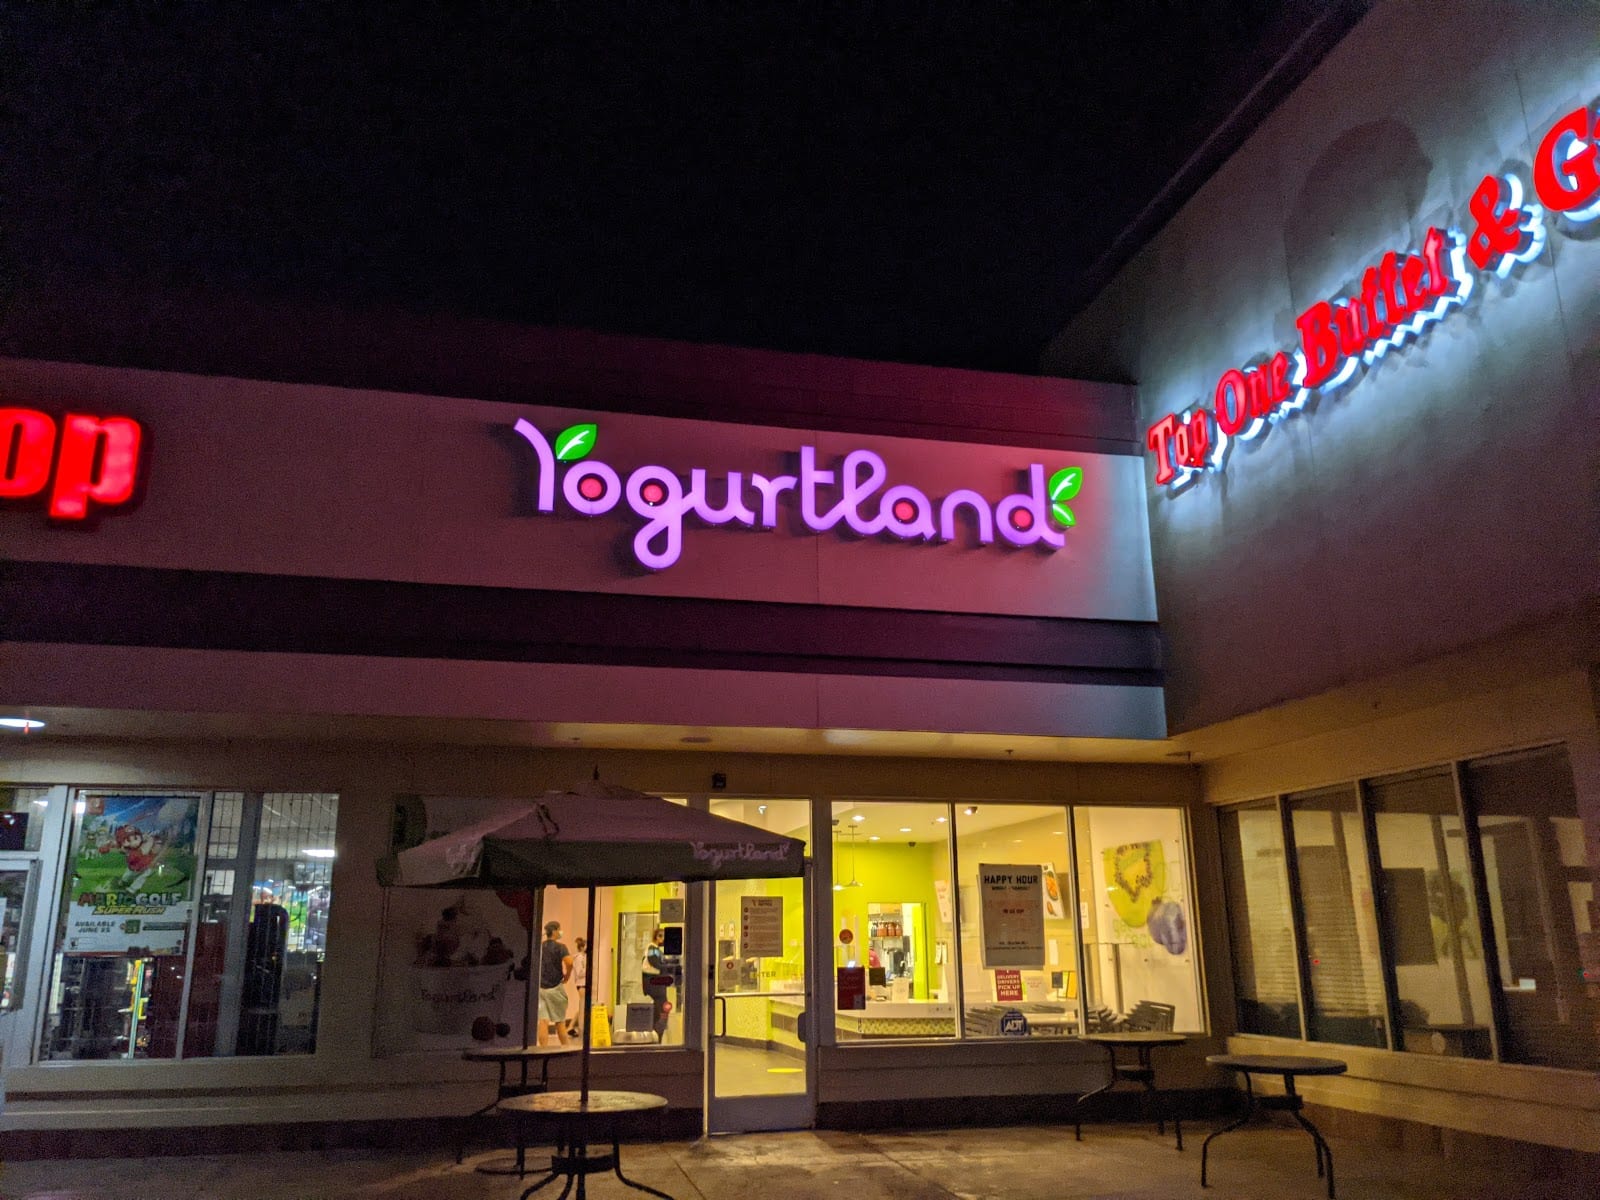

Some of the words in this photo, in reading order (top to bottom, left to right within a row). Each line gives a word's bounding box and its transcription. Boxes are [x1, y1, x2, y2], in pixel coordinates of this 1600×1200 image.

[1147, 408, 1209, 485] Top
[1215, 351, 1290, 436] One
[1296, 226, 1449, 389] Buffet
[1466, 174, 1521, 270] &
[1533, 105, 1600, 212] G
[513, 417, 1066, 570] Yogurtland
[984, 875, 1013, 884] HAPPY
[1016, 875, 1039, 884] HOUR
[135, 892, 182, 906] GOLF
[1005, 1019, 1024, 1032] ADT
